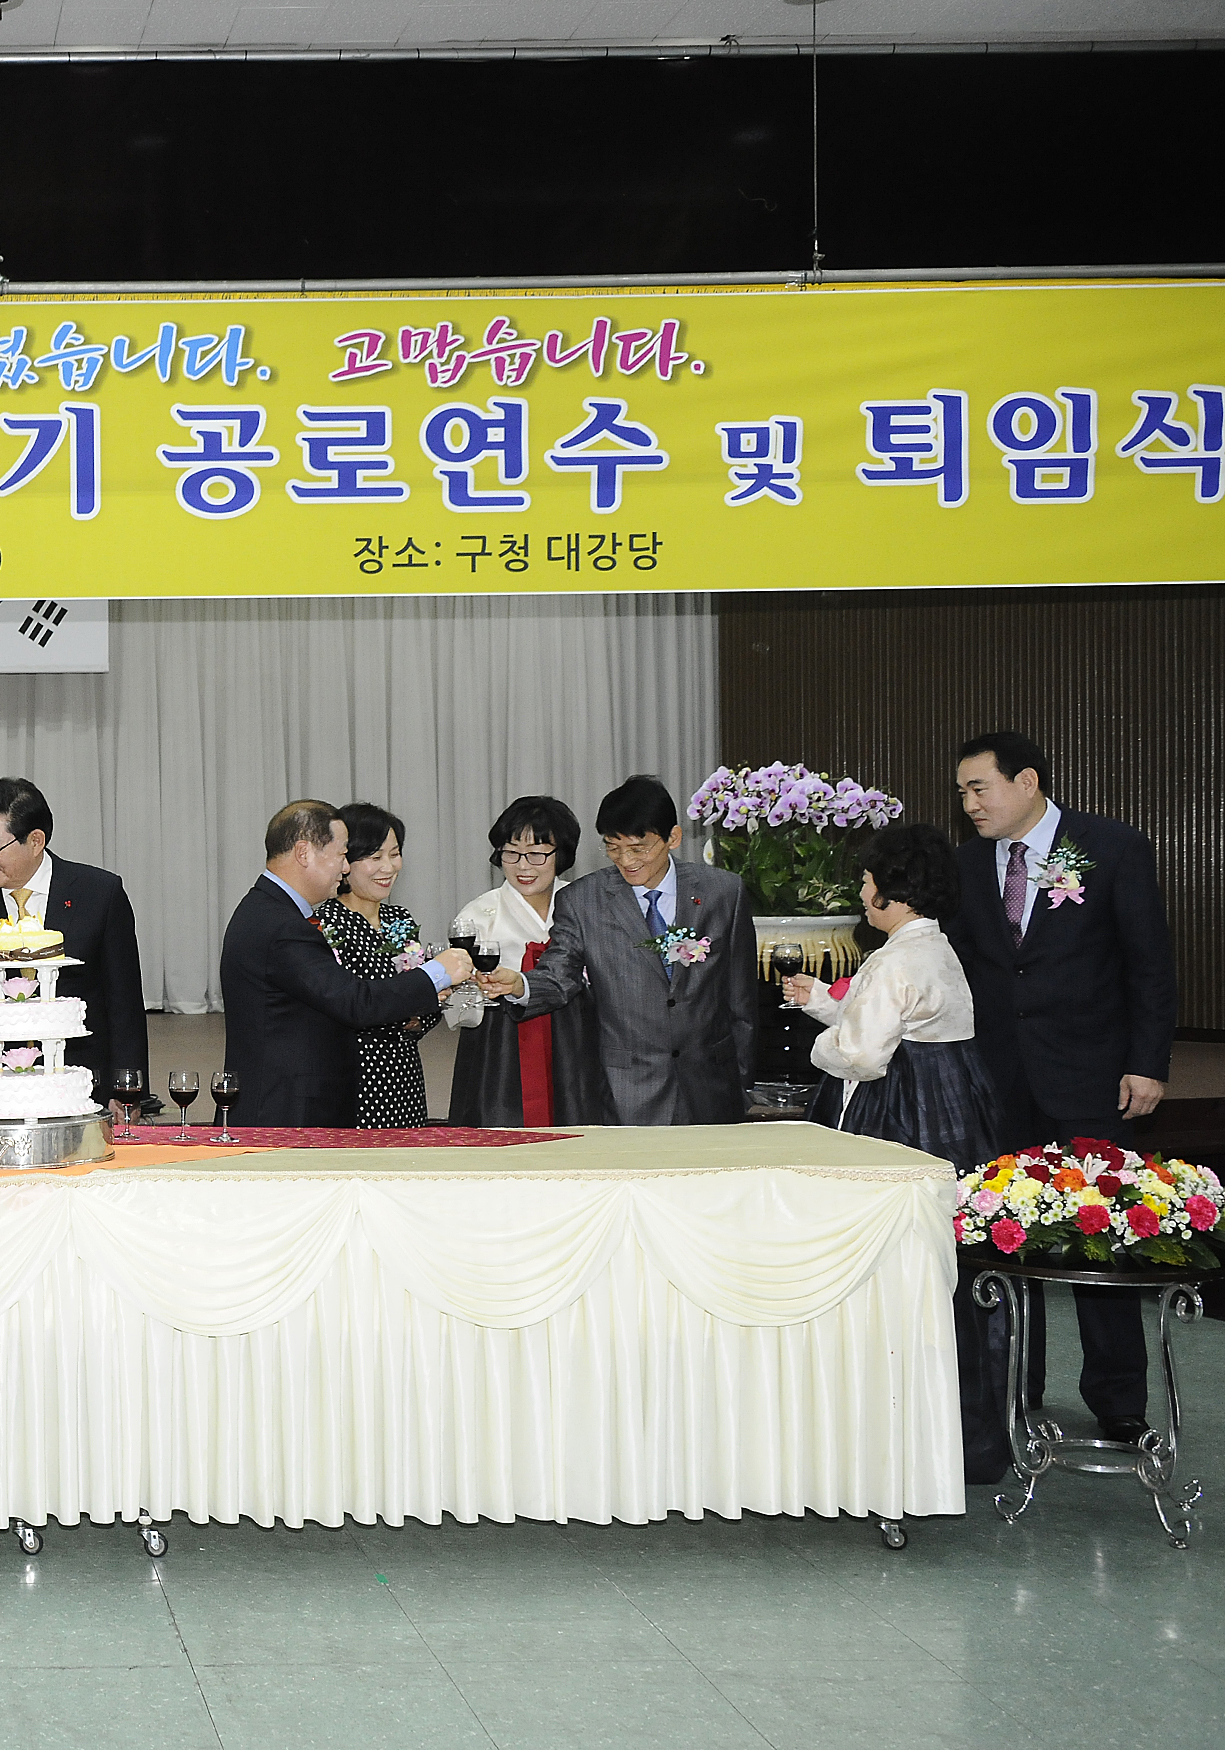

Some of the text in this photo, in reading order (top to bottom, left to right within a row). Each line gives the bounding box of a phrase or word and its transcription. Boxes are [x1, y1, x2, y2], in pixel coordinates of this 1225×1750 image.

[329, 316, 705, 388] 고맙습니다.
[158, 397, 668, 518] 공로연수
[717, 416, 802, 505] 및
[857, 385, 1225, 507] 퇴임식
[352, 530, 664, 576] 장소: 구청 대강당
